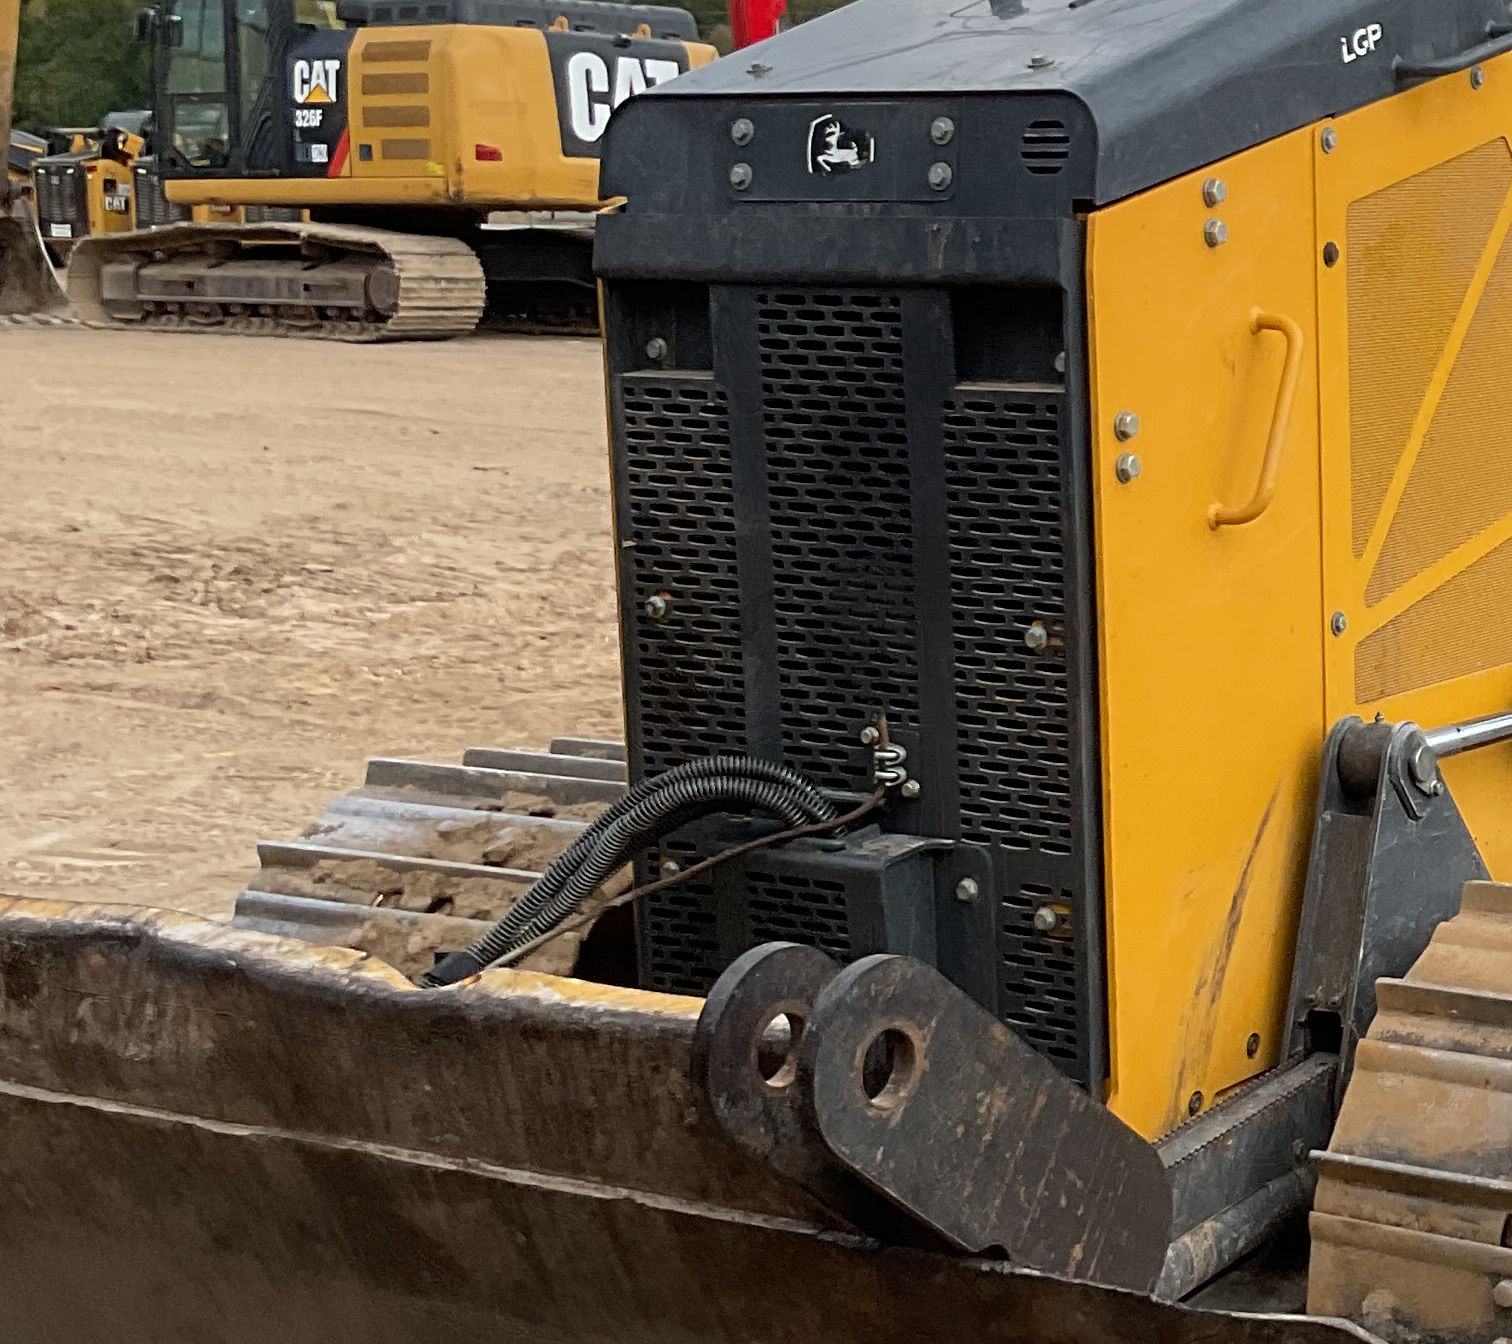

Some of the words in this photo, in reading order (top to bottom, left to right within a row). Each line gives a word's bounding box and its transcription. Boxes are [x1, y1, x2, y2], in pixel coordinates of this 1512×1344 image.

[1341, 23, 1382, 63] LGP
[294, 60, 340, 103] CAT
[295, 109, 323, 127] 326F
